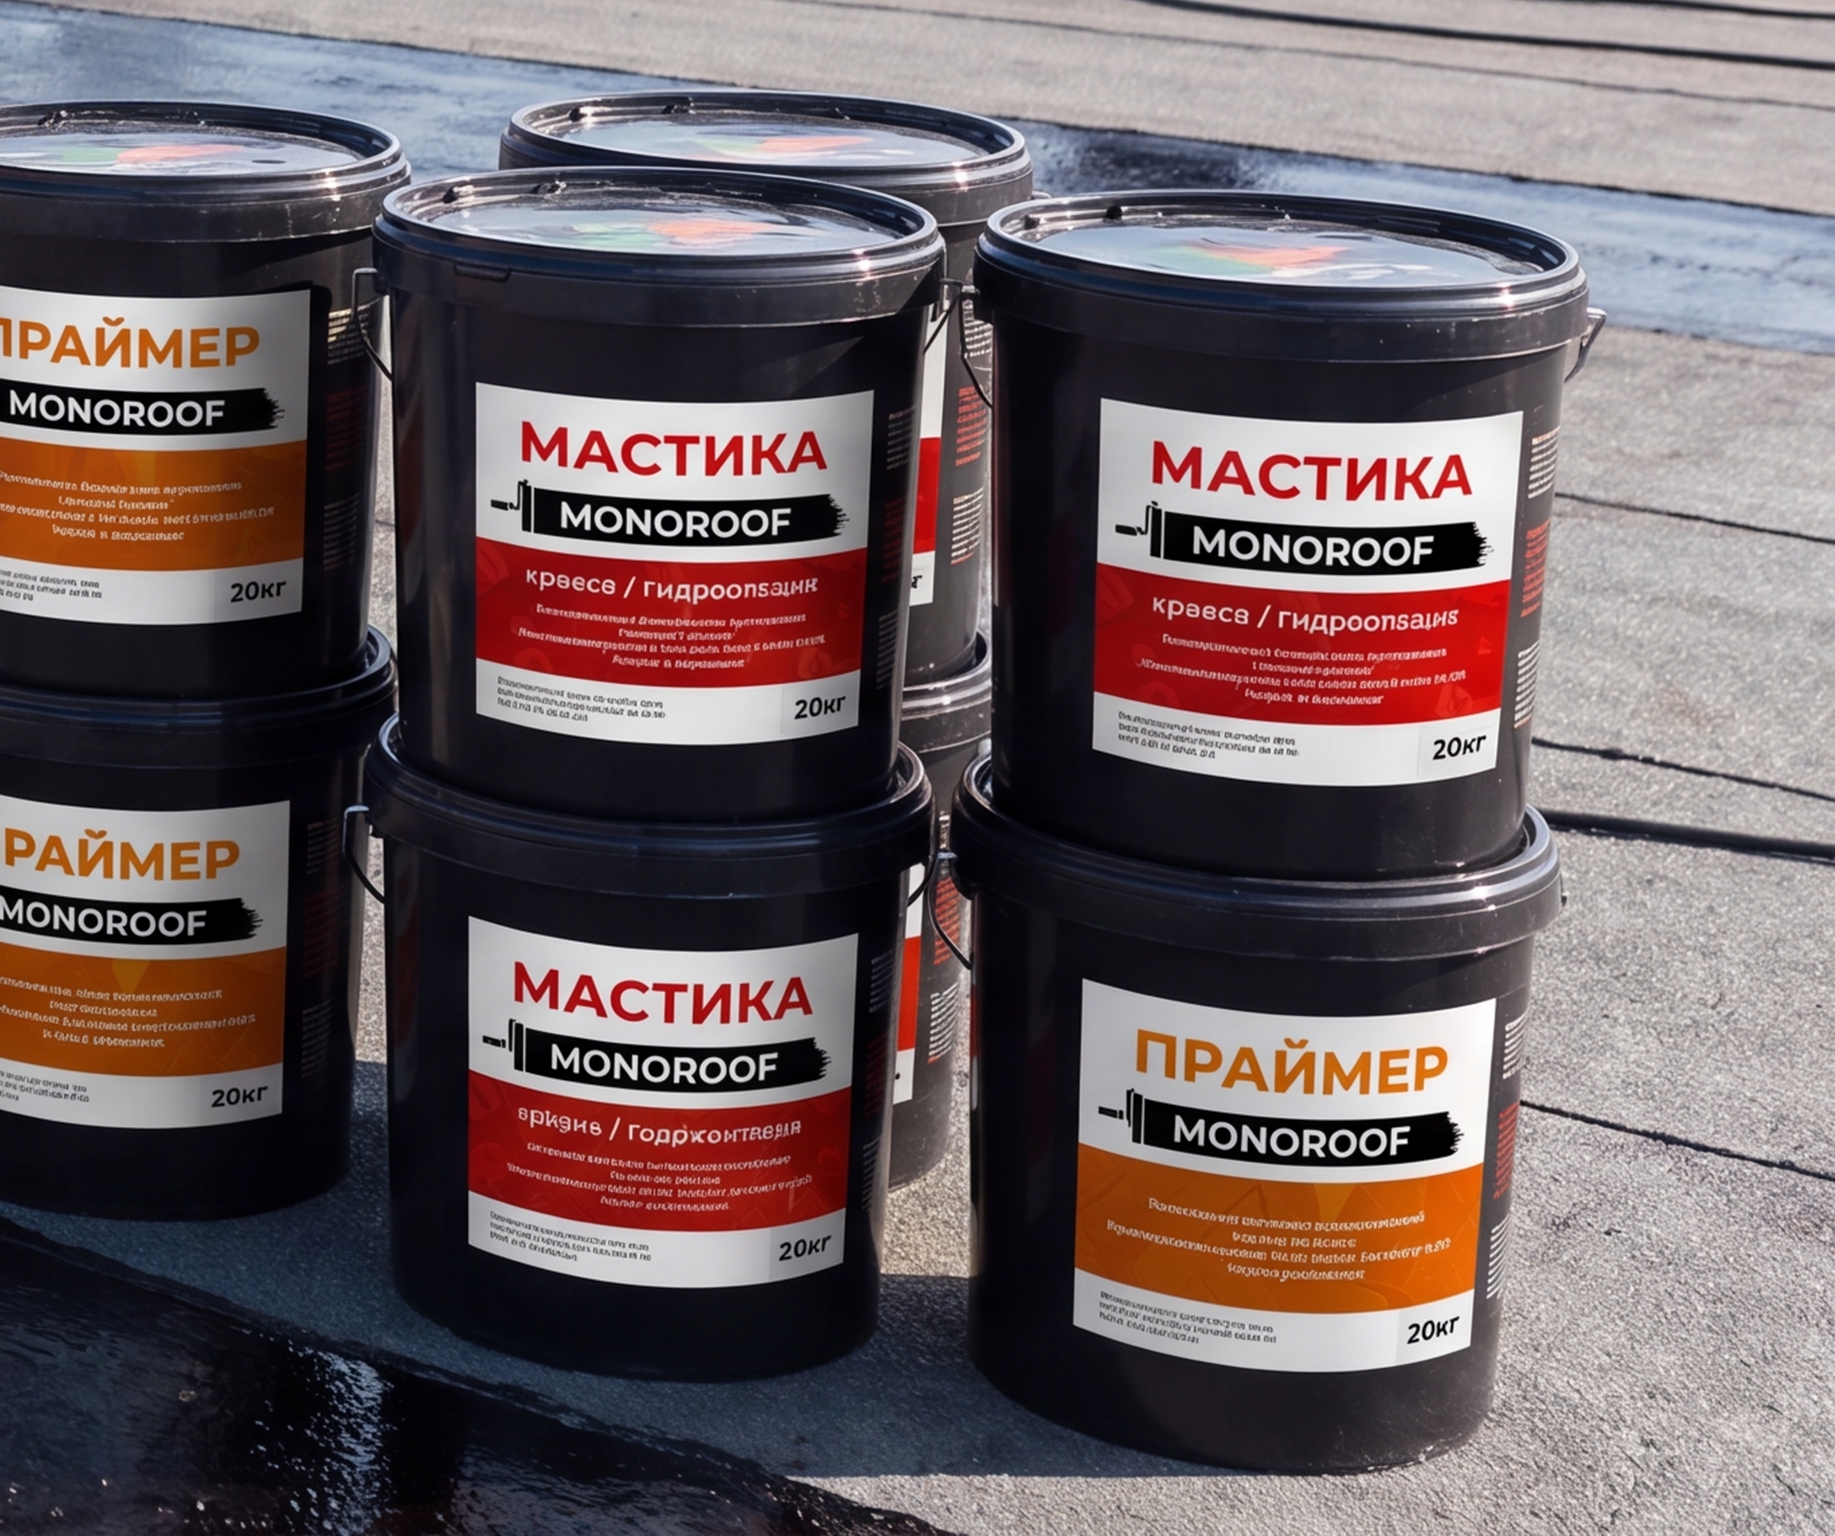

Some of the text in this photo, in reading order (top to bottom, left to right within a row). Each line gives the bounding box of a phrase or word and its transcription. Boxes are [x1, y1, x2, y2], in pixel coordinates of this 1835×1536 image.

[8, 388, 225, 428] MONOROOF
[521, 421, 827, 477] МАСТИКА
[1152, 440, 1473, 502] МАСТИКА
[560, 500, 792, 539] MONOROOF
[1192, 525, 1435, 567] MONOROOF
[230, 581, 288, 604] 20кг
[794, 695, 847, 720] 20кг
[1432, 735, 1487, 761] 20кг
[514, 961, 812, 1025] МАСТИКА
[550, 1043, 779, 1084] MONOROOF
[1136, 1028, 1450, 1096] ПРАЙМЕР
[210, 1086, 269, 1109] 20кг
[1173, 1114, 1412, 1159] MONOROOF
[778, 1234, 833, 1262] 20кг
[1407, 1316, 1460, 1345] 20кг
